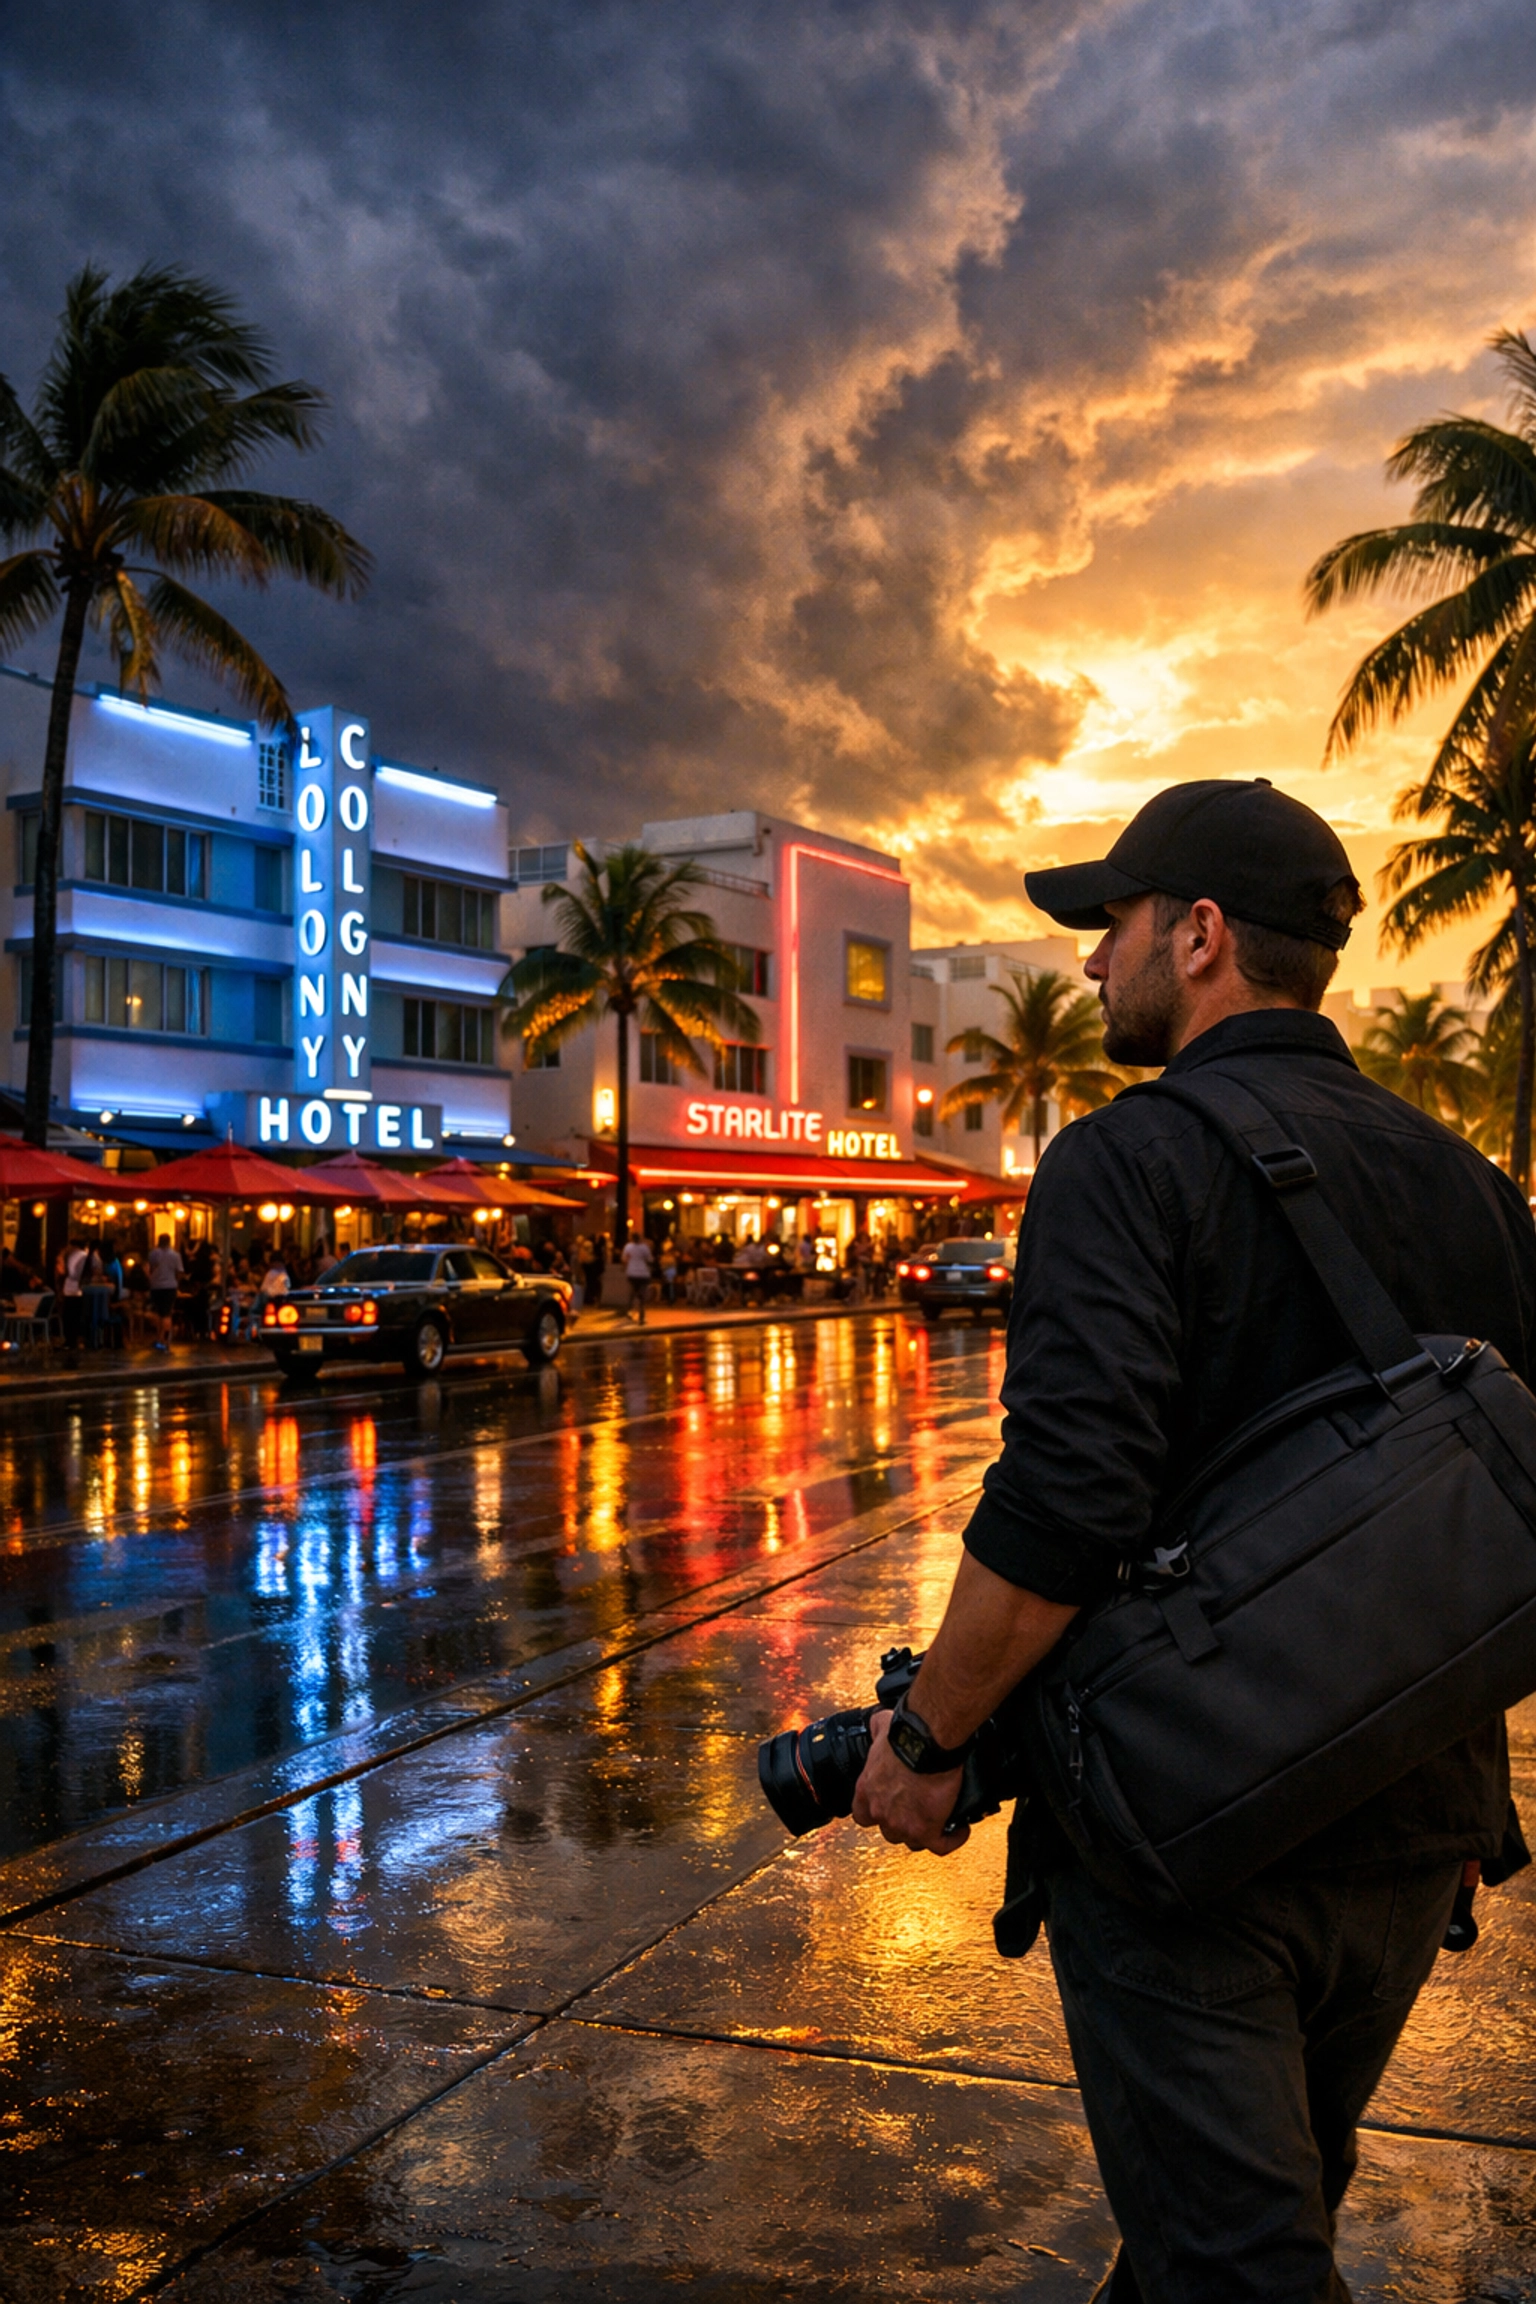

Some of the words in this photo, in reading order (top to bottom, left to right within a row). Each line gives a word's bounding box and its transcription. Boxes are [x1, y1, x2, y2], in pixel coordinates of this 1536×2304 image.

[340, 724, 368, 1078] COLGNY
[259, 1097, 434, 1149] HOTEL
[687, 1102, 823, 1142] STARLITE
[828, 1131, 902, 1159] HOTEL
